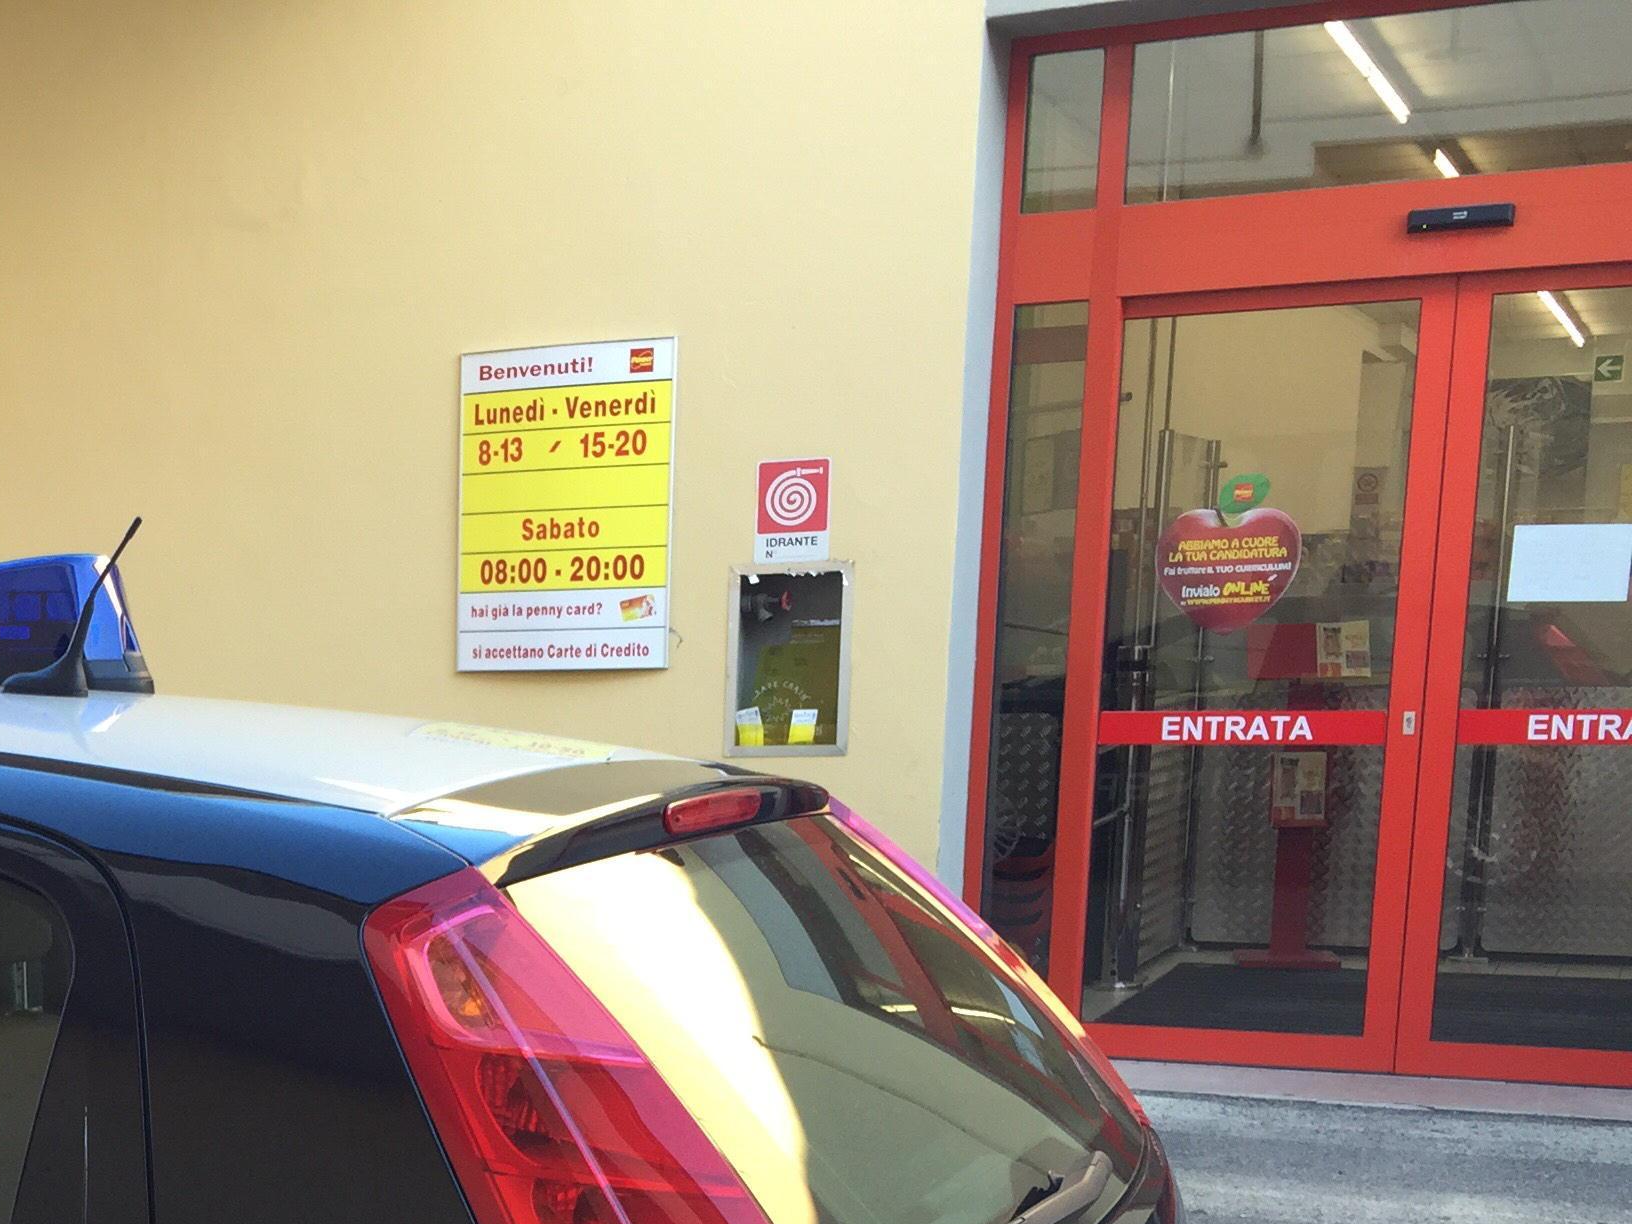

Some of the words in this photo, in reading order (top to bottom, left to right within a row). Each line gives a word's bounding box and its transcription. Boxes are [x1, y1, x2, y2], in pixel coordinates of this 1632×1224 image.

[479, 357, 593, 381] Benvenuti!
[474, 398, 545, 426] Lunedì
[565, 390, 657, 419] Venerdì
[478, 437, 523, 466] 8-13
[580, 429, 647, 458] 15-20
[522, 517, 600, 541] Sabato
[766, 536, 818, 548] IDRANTE
[1178, 539, 1229, 551] ABBIAMO
[1231, 538, 1240, 549] A
[1242, 536, 1279, 548] CUORE
[1168, 551, 1183, 562] LA
[1186, 550, 1207, 561] TUA
[1209, 547, 1288, 561] CANDIDATURA
[480, 557, 547, 585] 08:00
[570, 554, 645, 582] 20:00
[1182, 583, 1220, 598] Invialo
[471, 604, 489, 619] hai
[491, 603, 509, 620] già
[512, 604, 523, 617] la
[526, 604, 563, 620] penny
[566, 602, 603, 616] card?
[472, 644, 482, 659] si
[485, 644, 545, 660] accettano
[547, 644, 583, 659] Carte
[585, 643, 597, 658] di
[601, 642, 649, 658] Credito
[1161, 715, 1313, 741] ENTRATA
